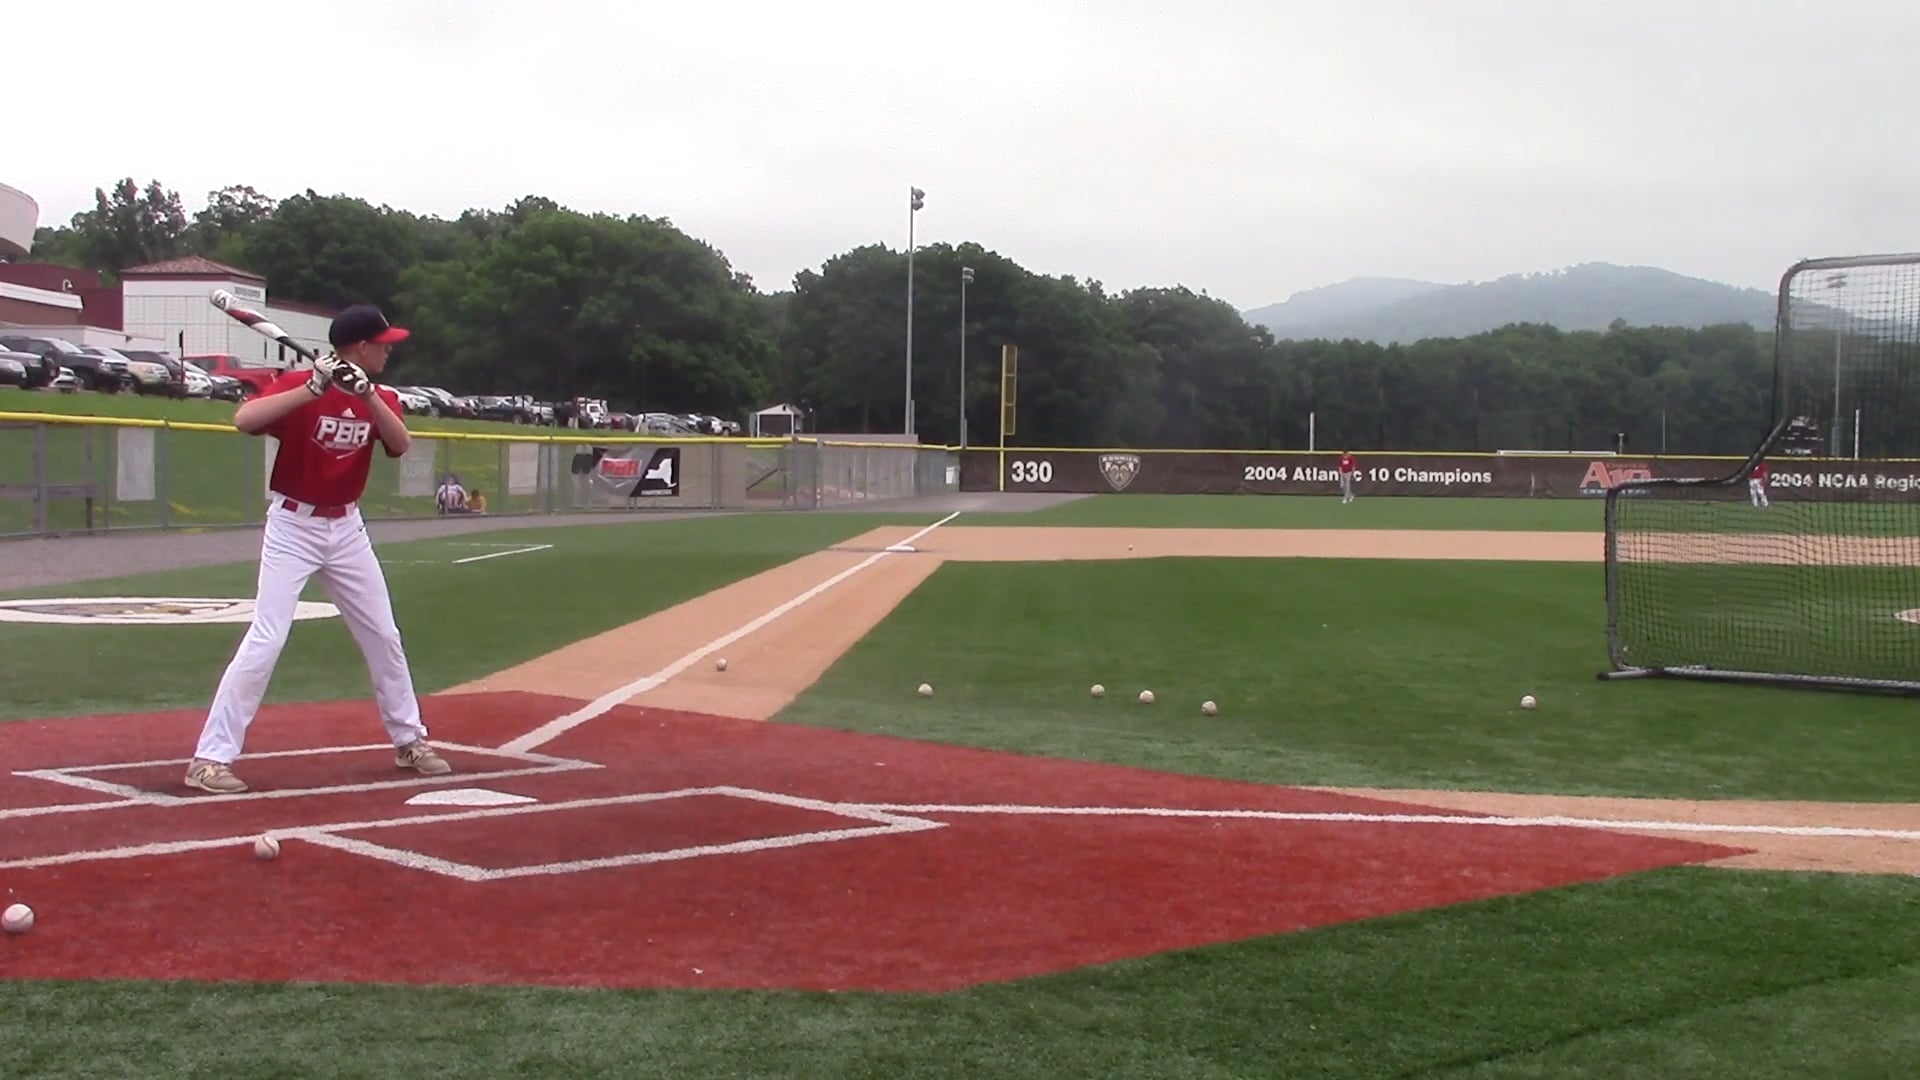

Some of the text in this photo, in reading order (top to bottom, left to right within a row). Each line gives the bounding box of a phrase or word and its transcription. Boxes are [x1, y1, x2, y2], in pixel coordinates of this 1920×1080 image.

[1011, 461, 1053, 483] 330
[1245, 466, 1492, 486] 2004 Atlanc 10 Champions
[1770, 472, 1813, 488] 2004
[1818, 473, 1868, 488] NCAA
